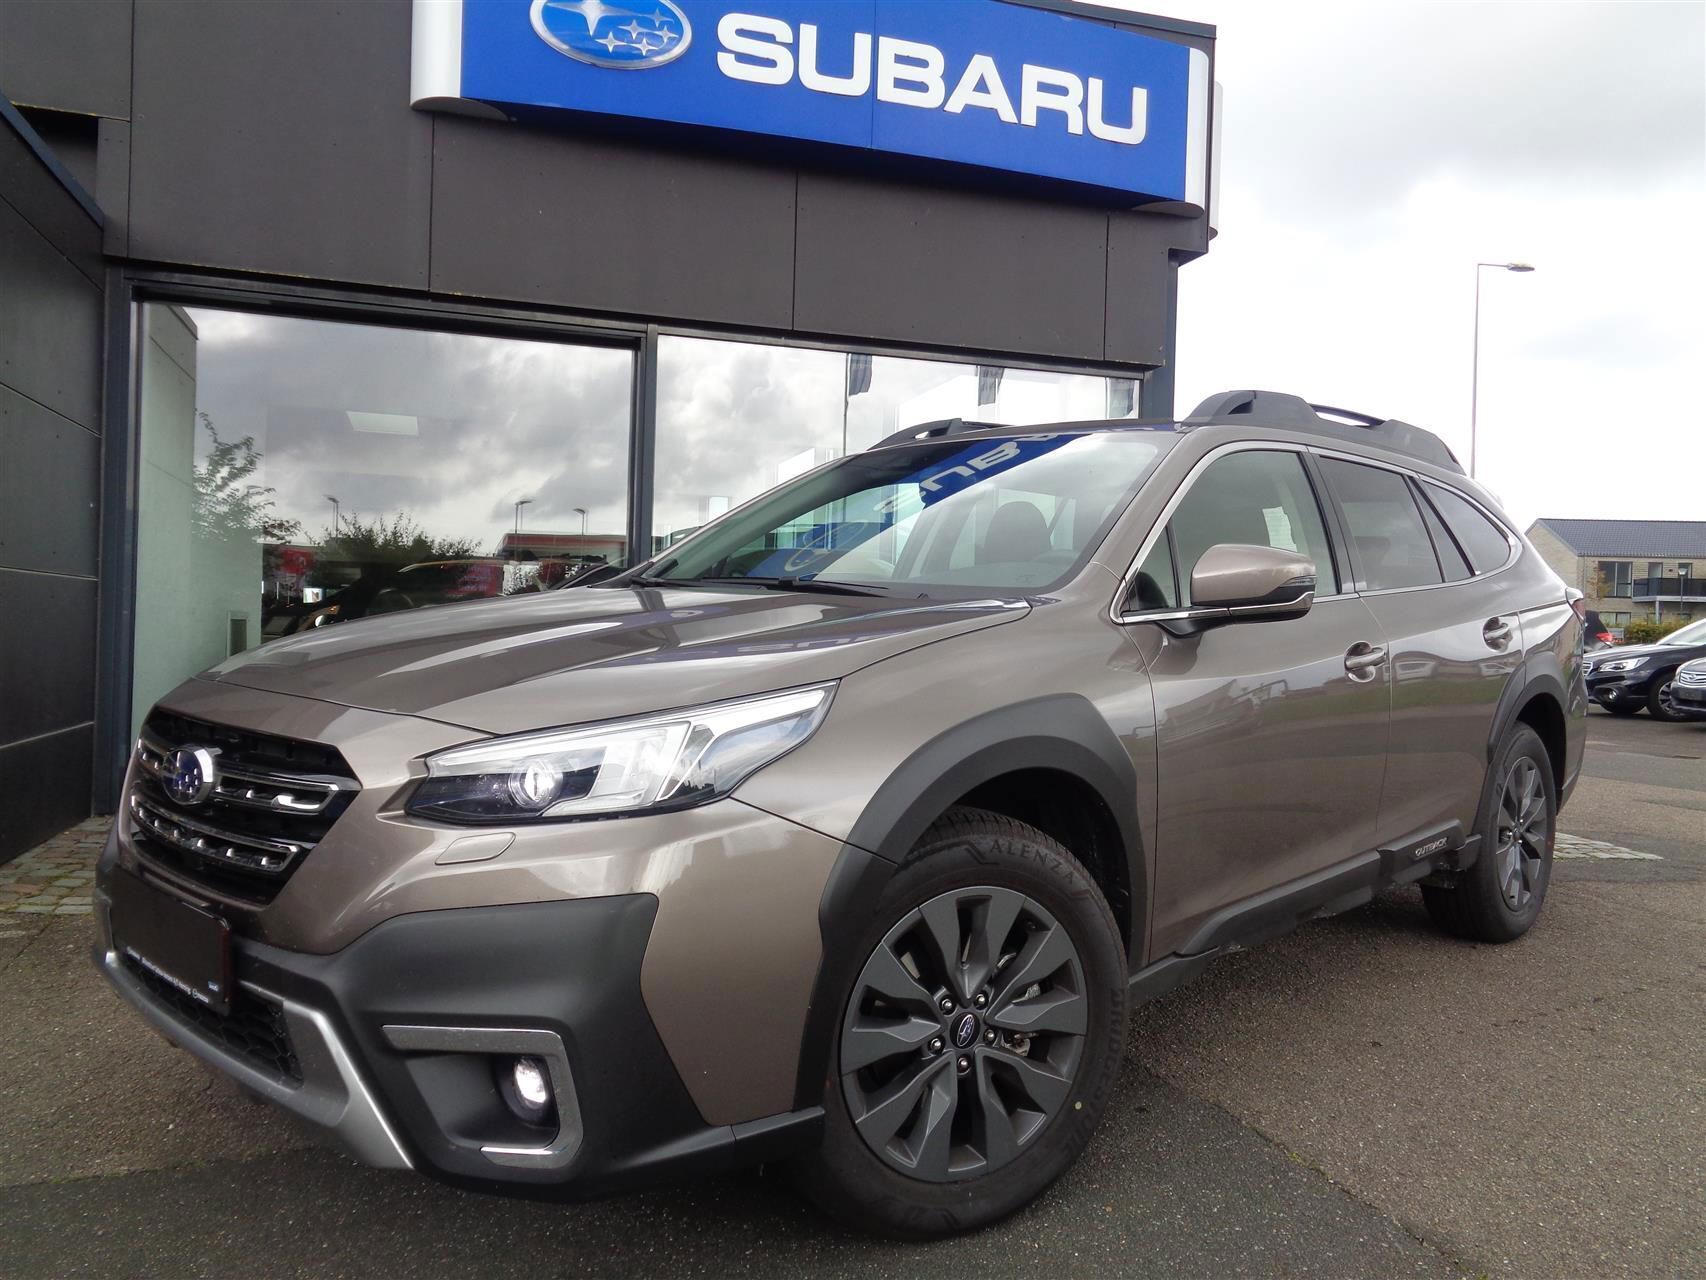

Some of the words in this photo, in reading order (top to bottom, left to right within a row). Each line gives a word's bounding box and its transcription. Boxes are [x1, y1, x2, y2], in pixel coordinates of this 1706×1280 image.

[716, 12, 1148, 146] SUBARU
[990, 838, 1075, 885] ALENZA
[1415, 836, 1448, 858] OUTBACK
